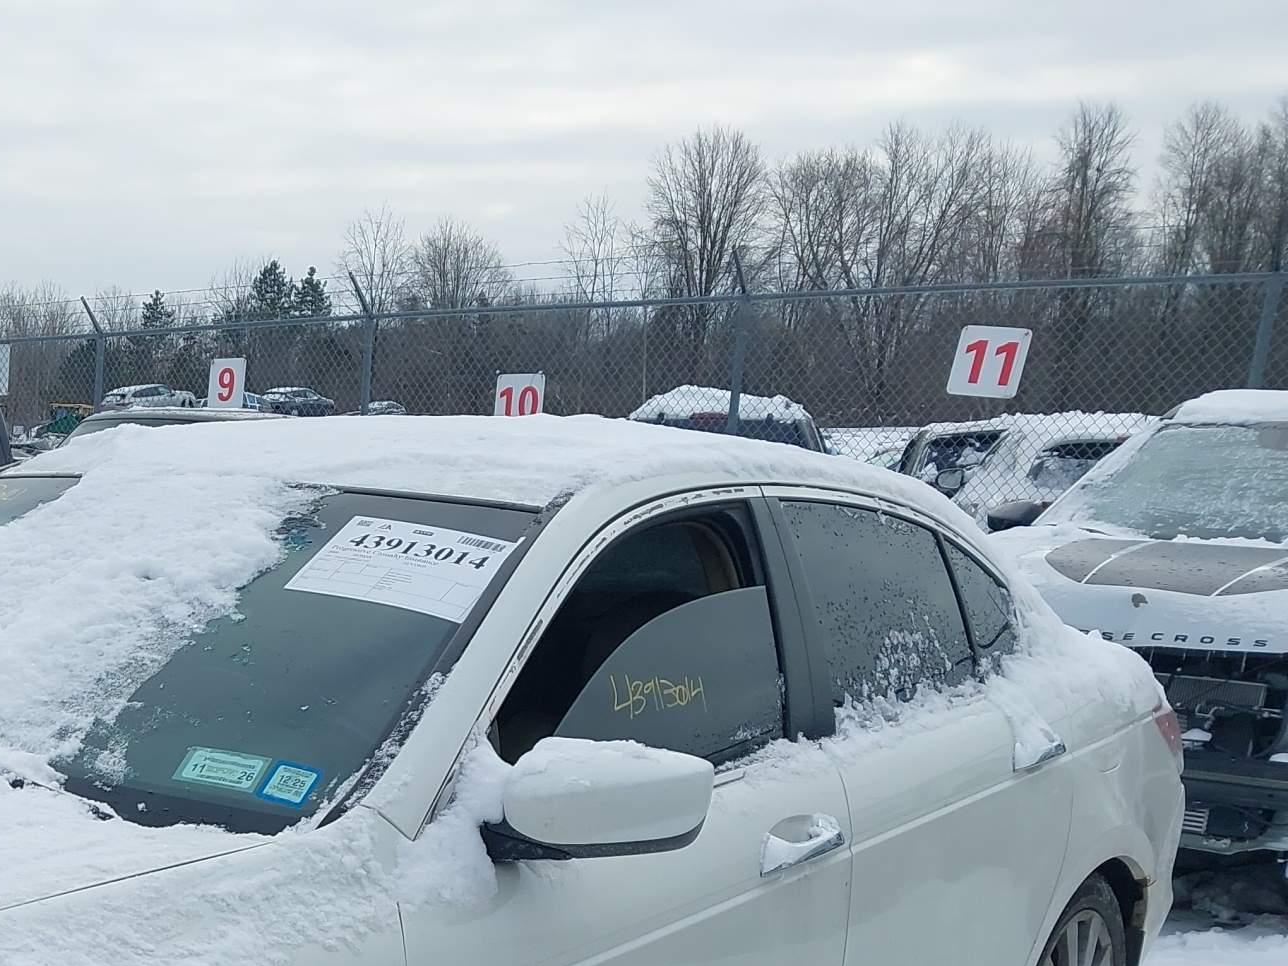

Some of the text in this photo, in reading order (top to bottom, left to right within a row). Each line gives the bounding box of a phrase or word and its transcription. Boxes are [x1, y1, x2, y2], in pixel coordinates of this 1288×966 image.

[965, 339, 1020, 386] 11
[218, 367, 235, 401] 9
[499, 386, 539, 416] 10
[349, 533, 492, 570] 43913014
[1151, 633, 1269, 647] CROSS
[610, 674, 708, 719] 43913014
[192, 763, 206, 773] 11
[237, 771, 255, 782] 26
